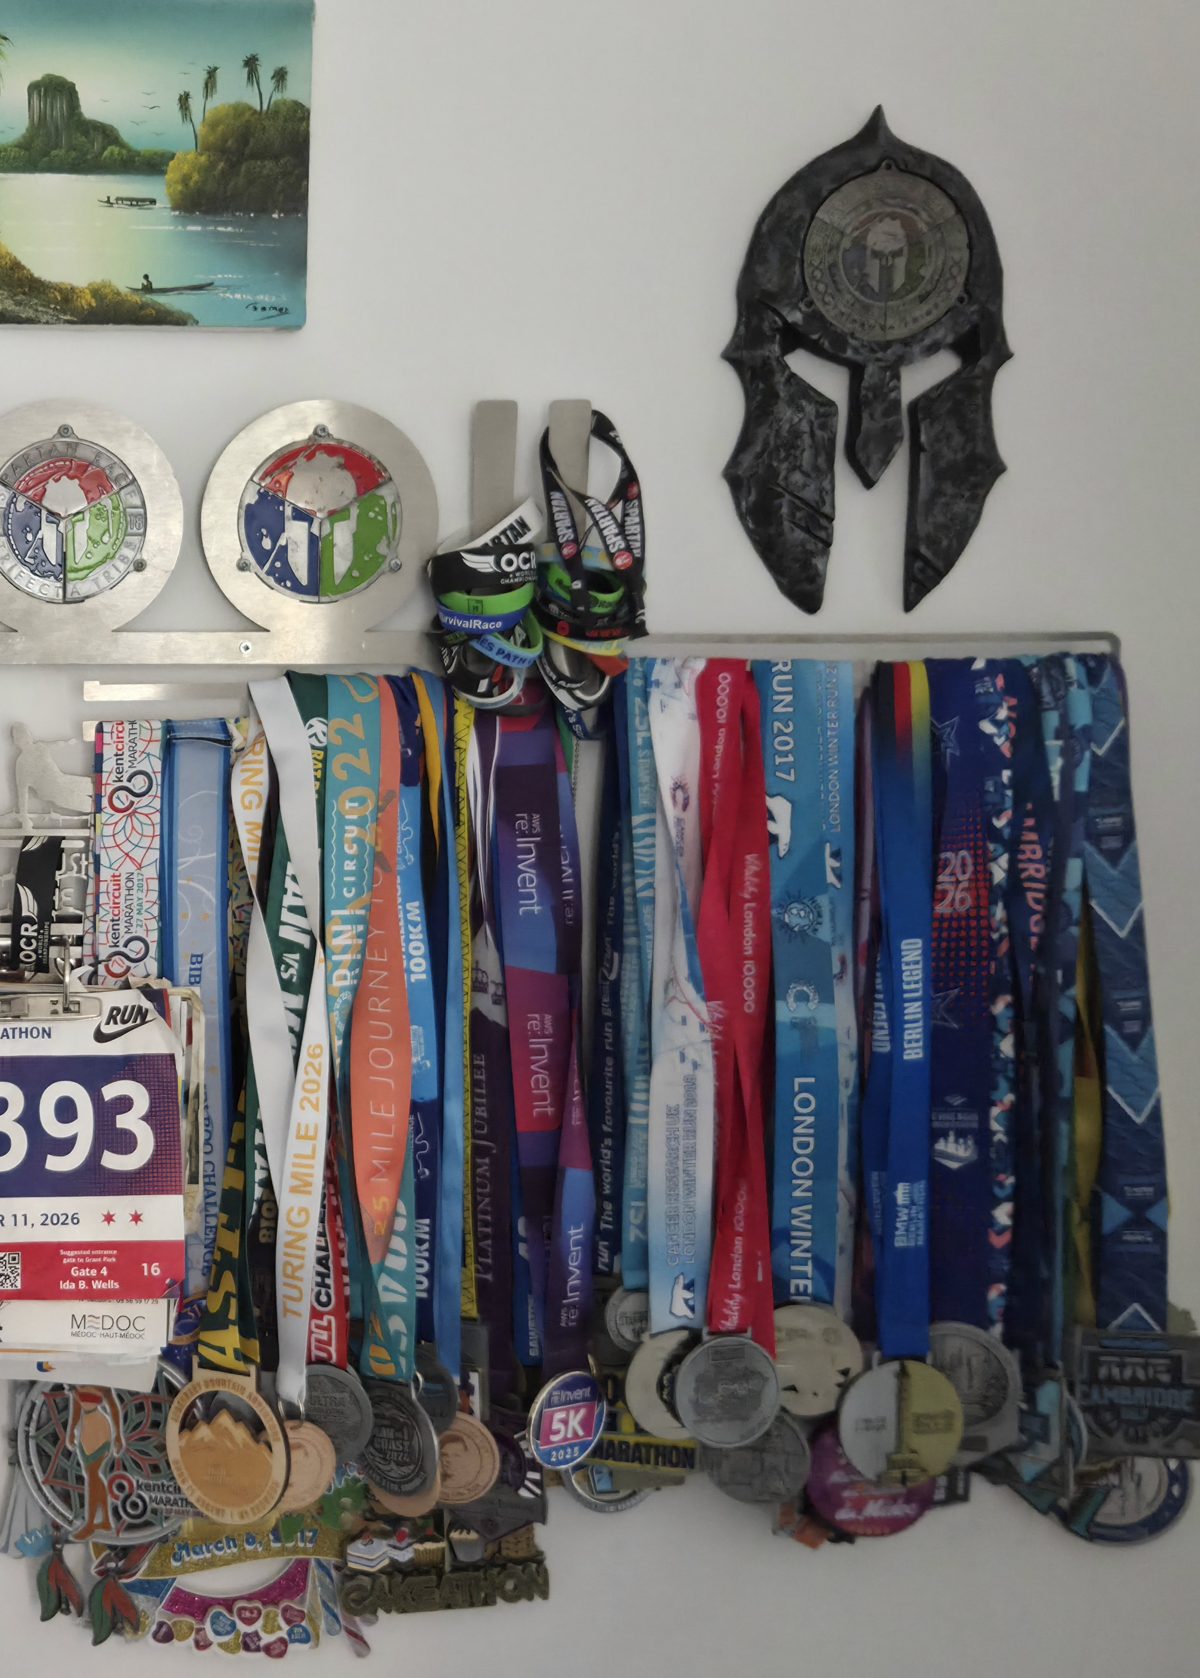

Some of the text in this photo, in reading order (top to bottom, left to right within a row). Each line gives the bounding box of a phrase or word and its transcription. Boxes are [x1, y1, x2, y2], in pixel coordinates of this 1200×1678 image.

[481, 515, 532, 549] RTAN
[585, 498, 626, 555] SPARTAN
[128, 720, 137, 768] MARATH
[770, 659, 795, 783] RUN 2017
[112, 720, 125, 783] kentcircu
[826, 677, 842, 833] LONDON WINTER RUN
[343, 800, 360, 898] CIRCUIT
[532, 813, 542, 834] AWS
[108, 872, 122, 948] kentcircuit
[125, 871, 135, 935] MARATHON
[136, 872, 144, 929] 27 MAY 2017
[19, 922, 39, 963] OCR
[409, 900, 424, 982] 100KM
[743, 901, 757, 957] London
[104, 1005, 151, 1027] RUN
[365, 926, 397, 1091] JOURNEY
[543, 1013, 552, 1034] AWS
[901, 938, 924, 1061] BERLIN LEGEND
[602, 1058, 615, 1139] favourite
[370, 1102, 396, 1182] MILE
[791, 1076, 816, 1197] LONDON
[281, 1042, 325, 1320] TURING MILE 2026
[472, 1054, 497, 1283] PLATINUM JUBILEE
[601, 1144, 613, 1194] world's
[11, 1213, 36, 1230] 11,
[40, 1212, 81, 1228] 2026
[202, 1160, 218, 1277] CHALLENGE
[598, 1208, 612, 1237] The
[894, 1208, 910, 1247] BMW
[59, 1279, 120, 1290] Ida B. Wells
[70, 1266, 108, 1277] Gate 4
[141, 1262, 161, 1276] 16
[729, 1235, 744, 1288] London
[549, 1407, 587, 1443] 5K
[550, 1446, 580, 1462] 2025
[170, 1535, 239, 1567] March
[269, 1527, 320, 1548] 217
